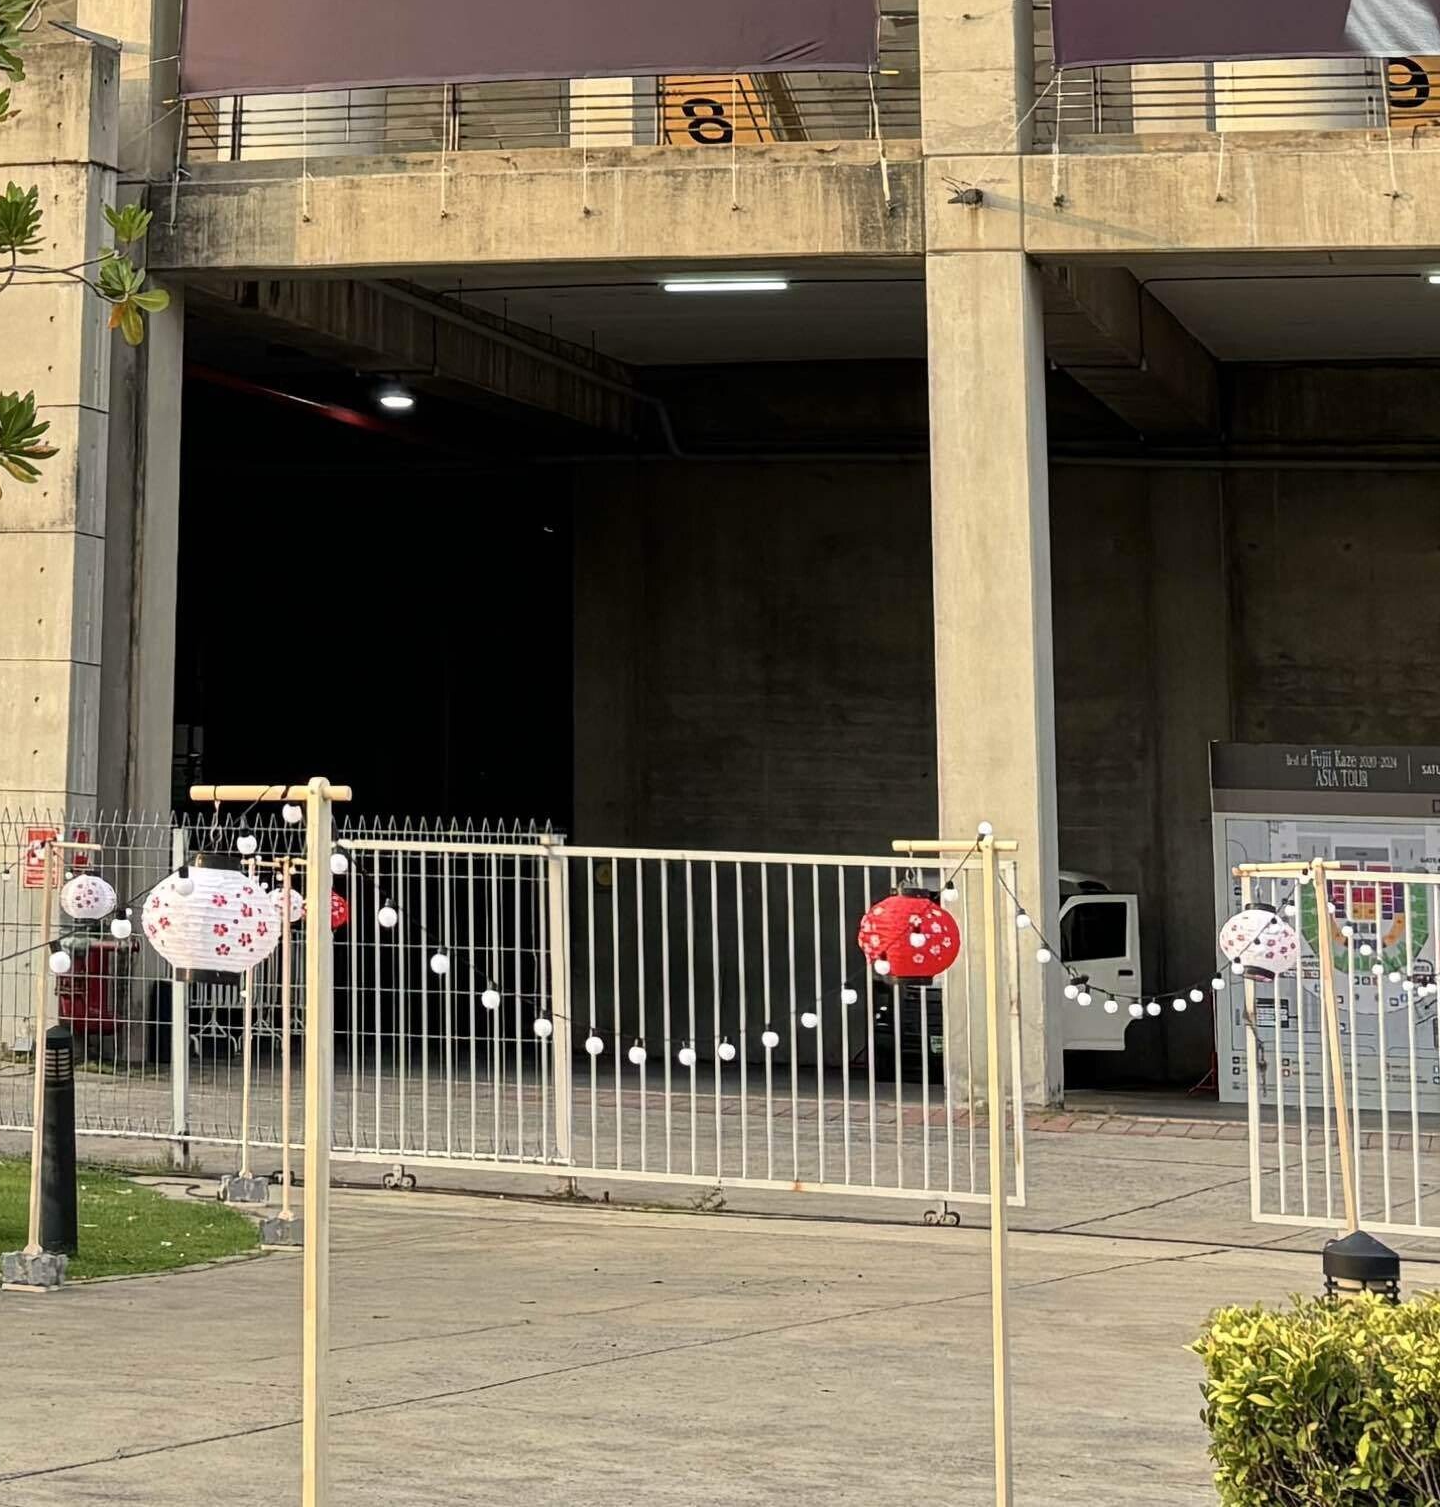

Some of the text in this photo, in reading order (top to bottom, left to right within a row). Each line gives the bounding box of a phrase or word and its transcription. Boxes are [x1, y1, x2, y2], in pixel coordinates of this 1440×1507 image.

[681, 97, 734, 145] 8
[1316, 769, 1368, 787] ASIA TOUR
